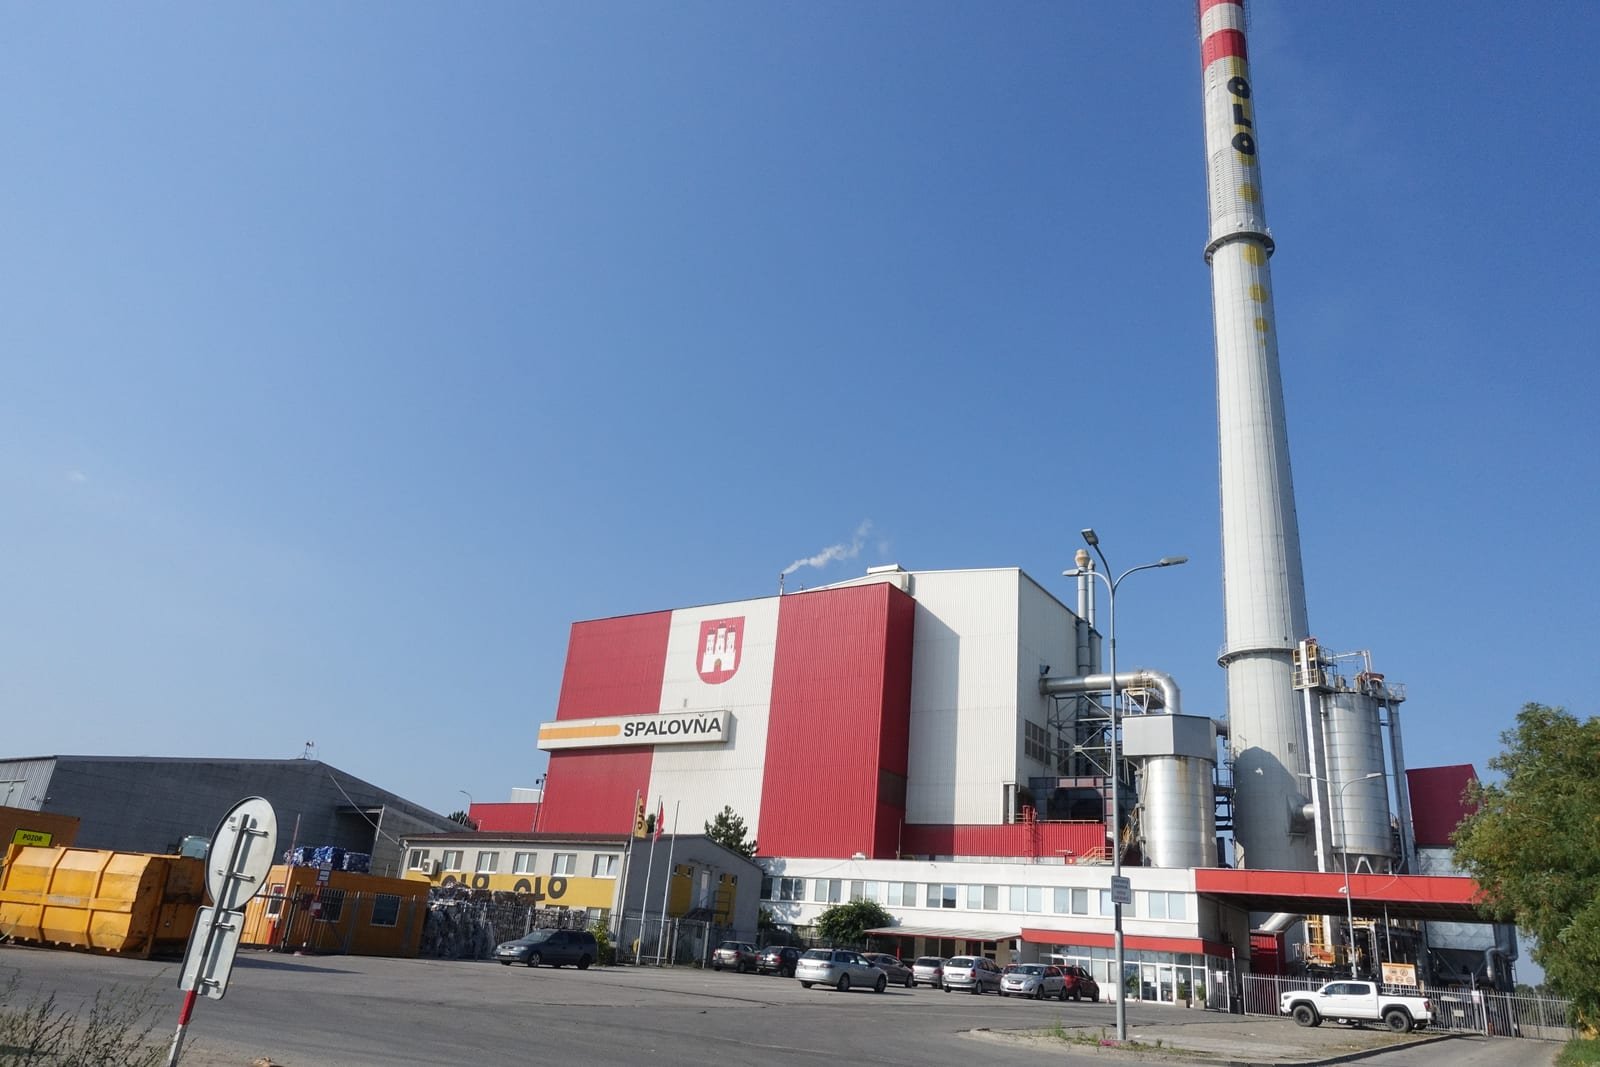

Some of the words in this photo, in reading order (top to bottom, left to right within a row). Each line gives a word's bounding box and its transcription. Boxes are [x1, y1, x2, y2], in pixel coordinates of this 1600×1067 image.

[1227, 76, 1255, 155] OLO
[624, 714, 721, 737] SPAĽOVŇA
[22, 833, 44, 842] POZOR
